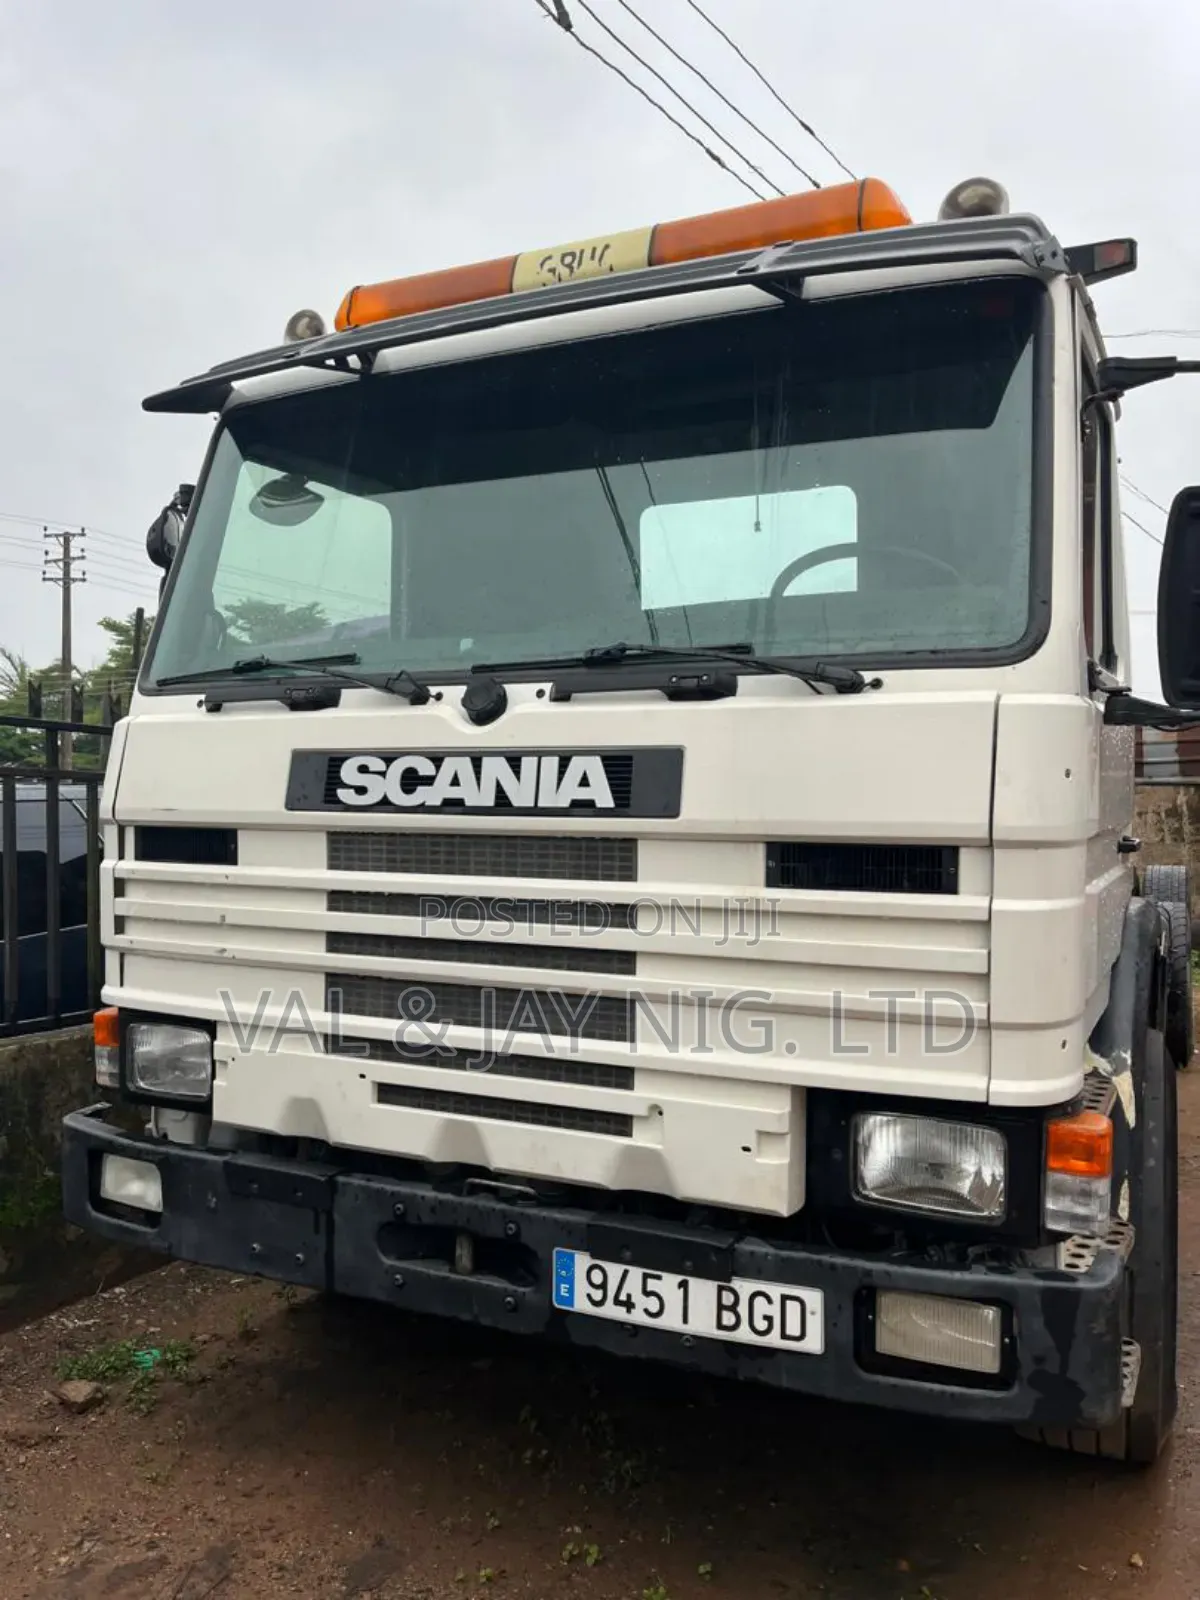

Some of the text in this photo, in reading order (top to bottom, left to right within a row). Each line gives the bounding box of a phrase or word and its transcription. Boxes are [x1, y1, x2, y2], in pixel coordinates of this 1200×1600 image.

[336, 755, 616, 808] SCANIA
[560, 1283, 570, 1297] E
[586, 1263, 807, 1342] 9451 BGD
